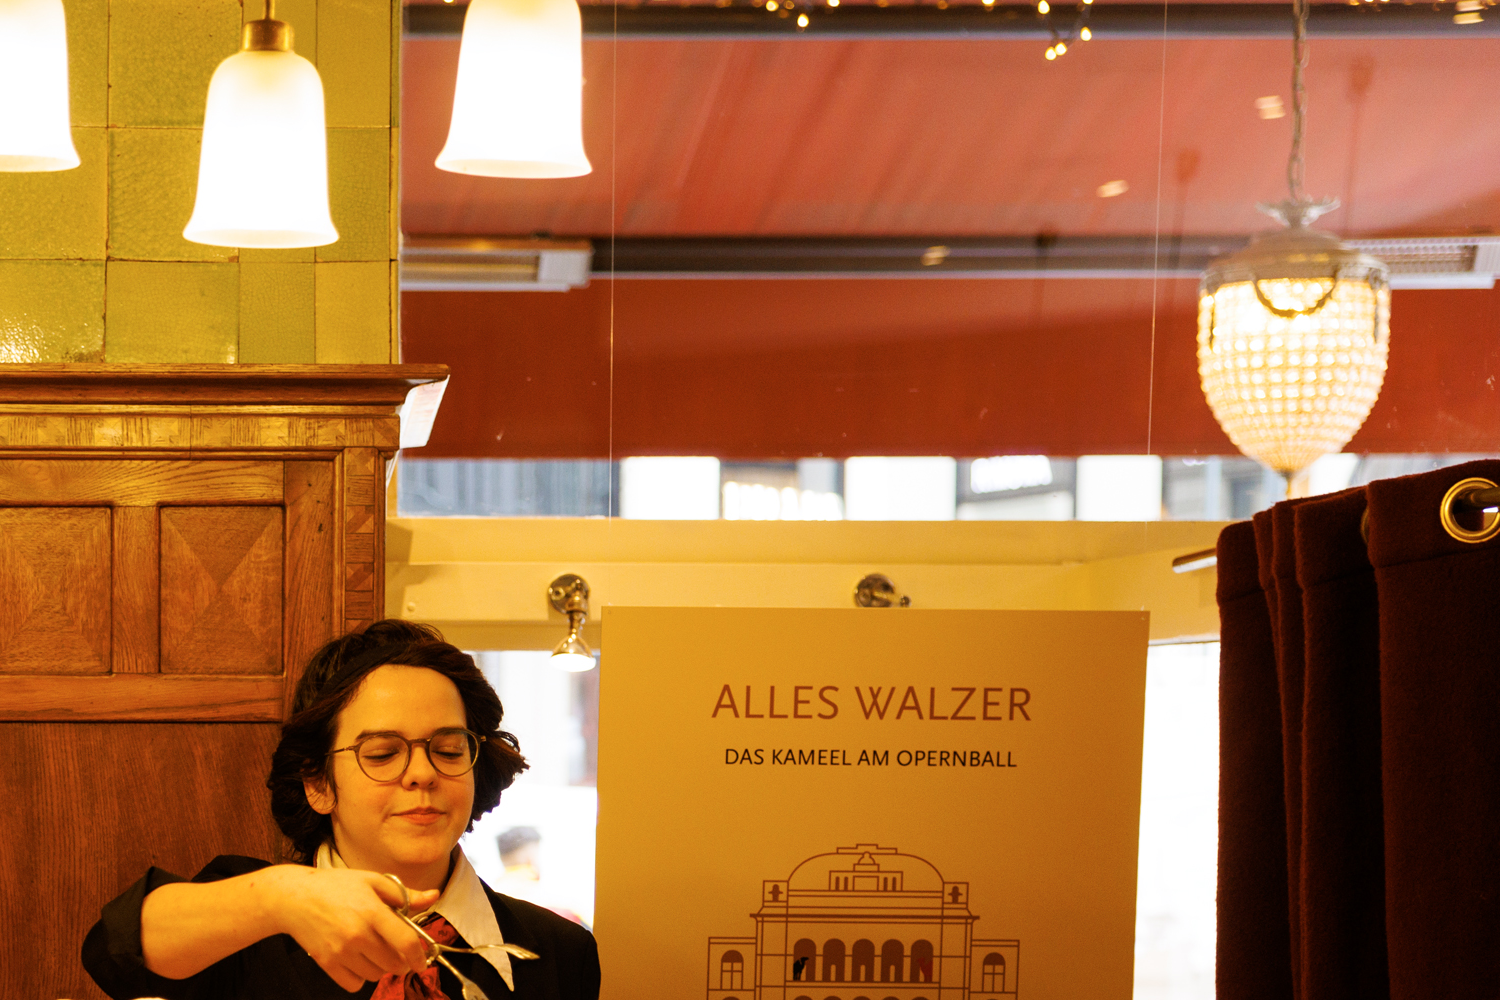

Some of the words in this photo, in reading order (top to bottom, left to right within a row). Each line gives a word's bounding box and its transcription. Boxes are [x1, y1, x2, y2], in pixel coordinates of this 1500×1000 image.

[711, 684, 840, 720] ALLES
[854, 685, 1032, 721] WALZER
[725, 748, 765, 765] DAS
[771, 749, 852, 766] KAMEEL
[856, 749, 890, 766] AM
[896, 749, 1018, 768] OPERNBALL
